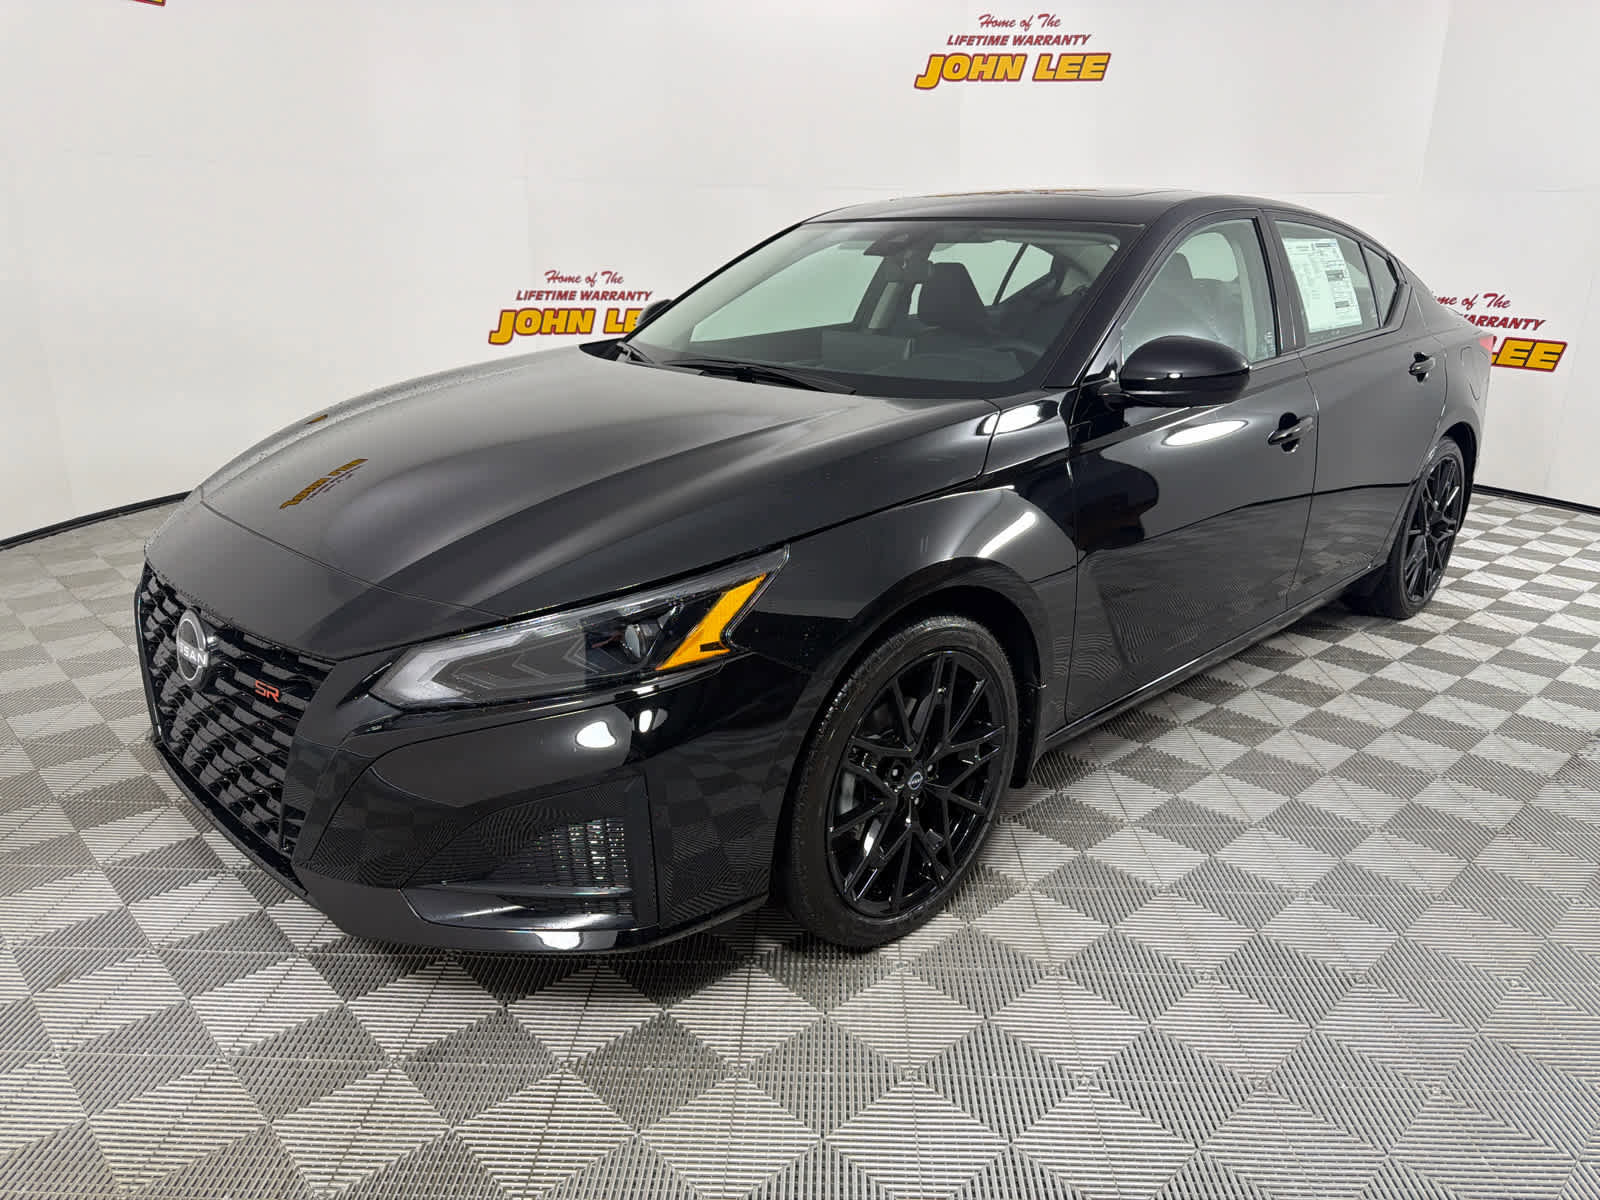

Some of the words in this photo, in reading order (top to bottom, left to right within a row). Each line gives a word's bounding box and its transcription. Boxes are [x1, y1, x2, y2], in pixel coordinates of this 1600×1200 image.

[978, 14, 1016, 29] Home
[1019, 15, 1034, 32] of
[1037, 13, 1061, 28] The
[947, 35, 1010, 46] LIFETIME
[1012, 34, 1092, 46] WARRANTY
[914, 53, 1027, 90] JOHN
[1032, 53, 1111, 82] LEE
[544, 270, 582, 285] Home
[584, 272, 597, 288] of
[601, 271, 624, 285] The
[515, 290, 577, 301] LIFETIME
[580, 291, 653, 301] WARRANTY
[1436, 296, 1457, 306] me
[1461, 294, 1479, 311] of
[1483, 293, 1512, 309] The
[488, 308, 596, 345] JOHN
[603, 308, 644, 334] LE
[1464, 314, 1546, 331] ARRANTY
[255, 679, 280, 703] SR
